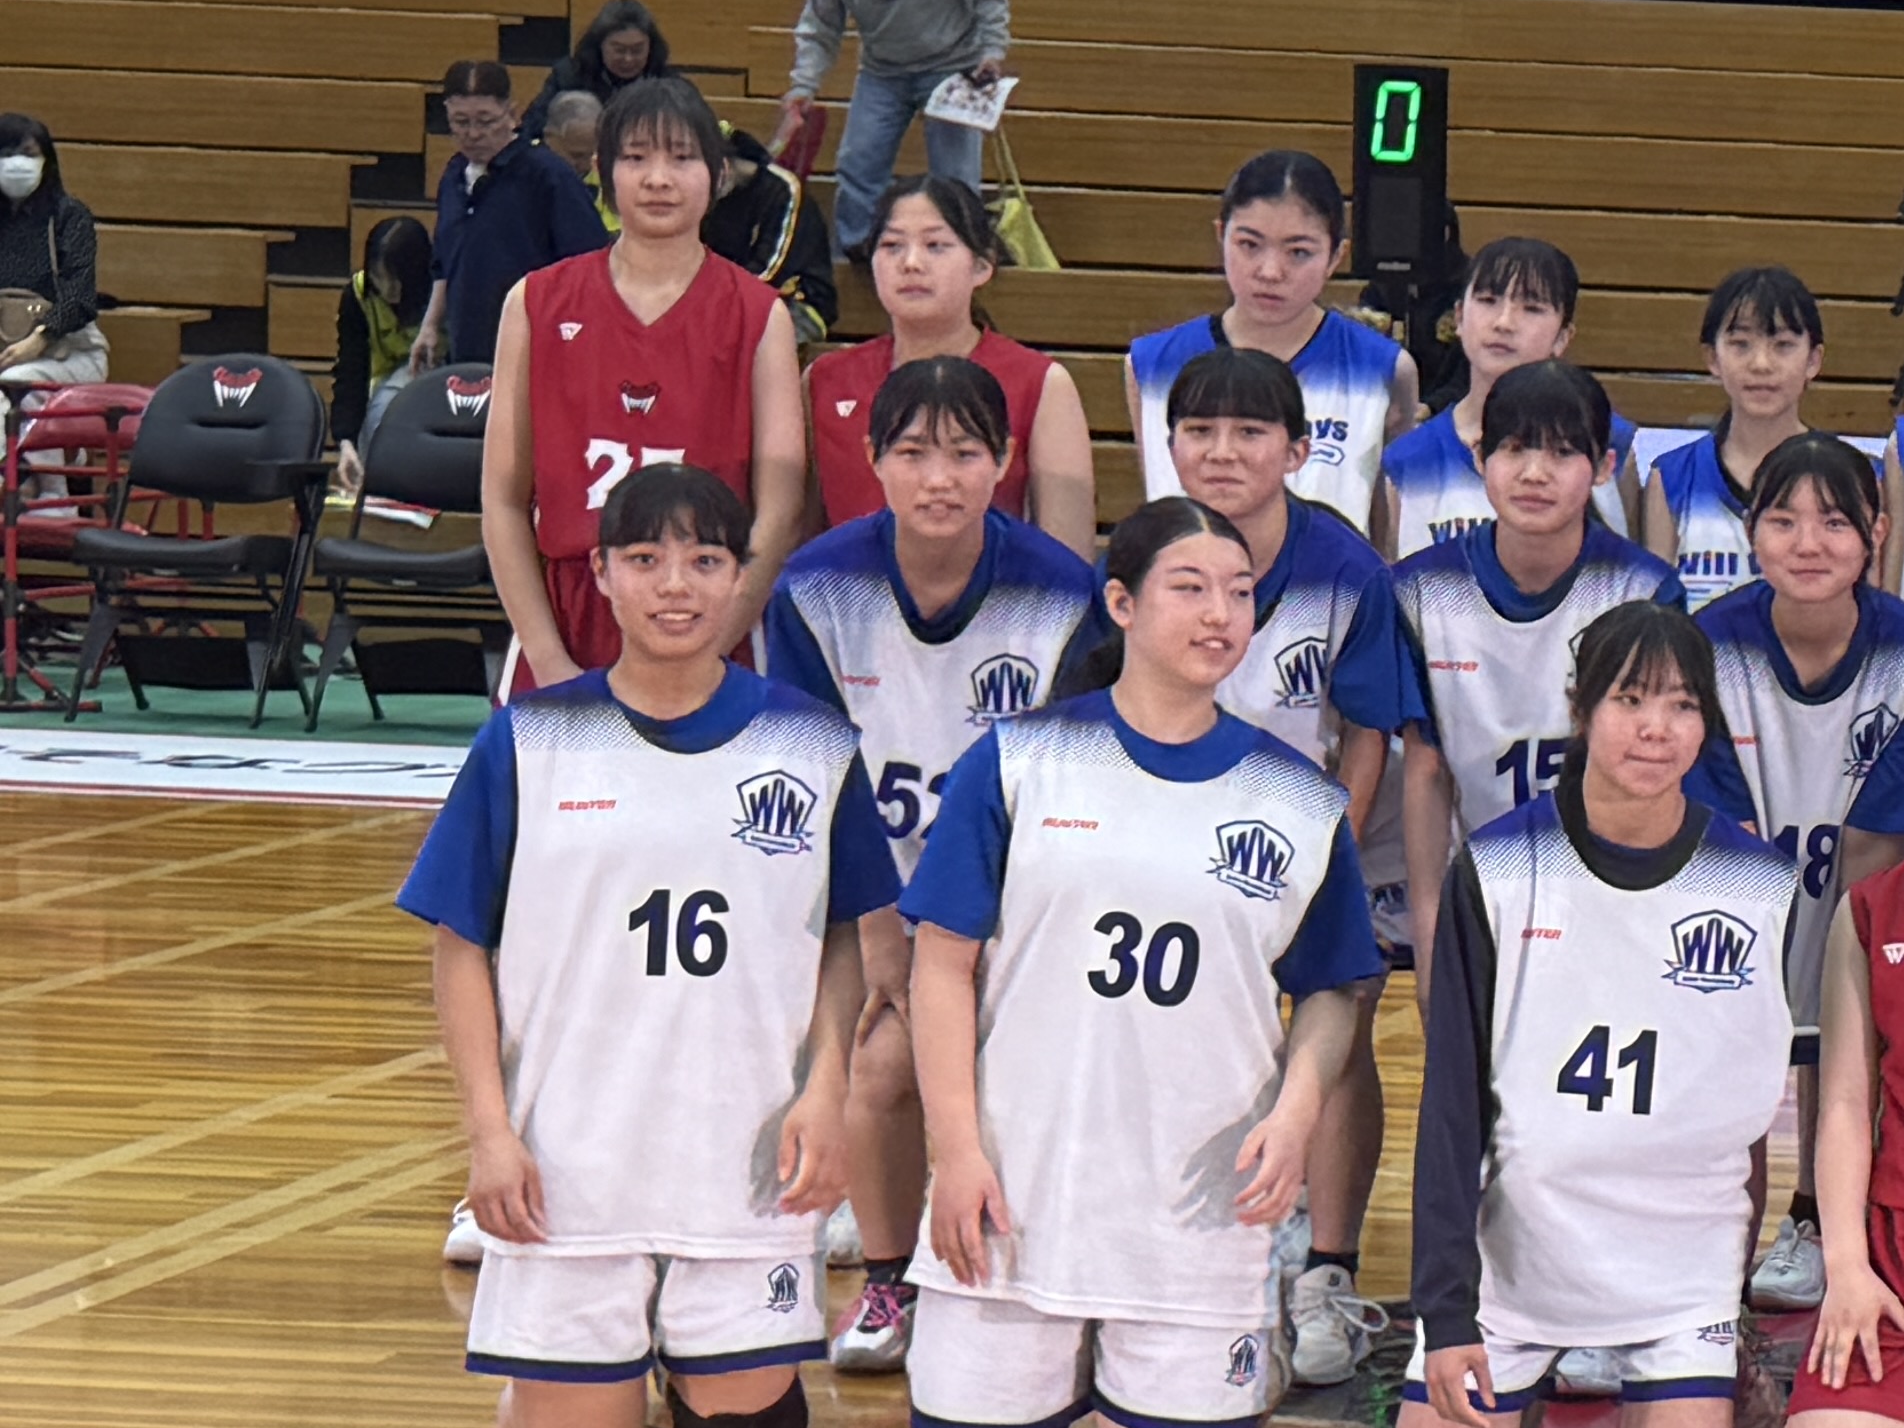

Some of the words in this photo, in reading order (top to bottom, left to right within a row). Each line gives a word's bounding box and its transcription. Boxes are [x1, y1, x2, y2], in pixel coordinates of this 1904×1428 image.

[1370, 80, 1422, 164] 0
[584, 438, 686, 510] 2
[628, 888, 730, 977] 16
[1087, 911, 1201, 1008] 30
[1556, 1024, 1659, 1116] 41
